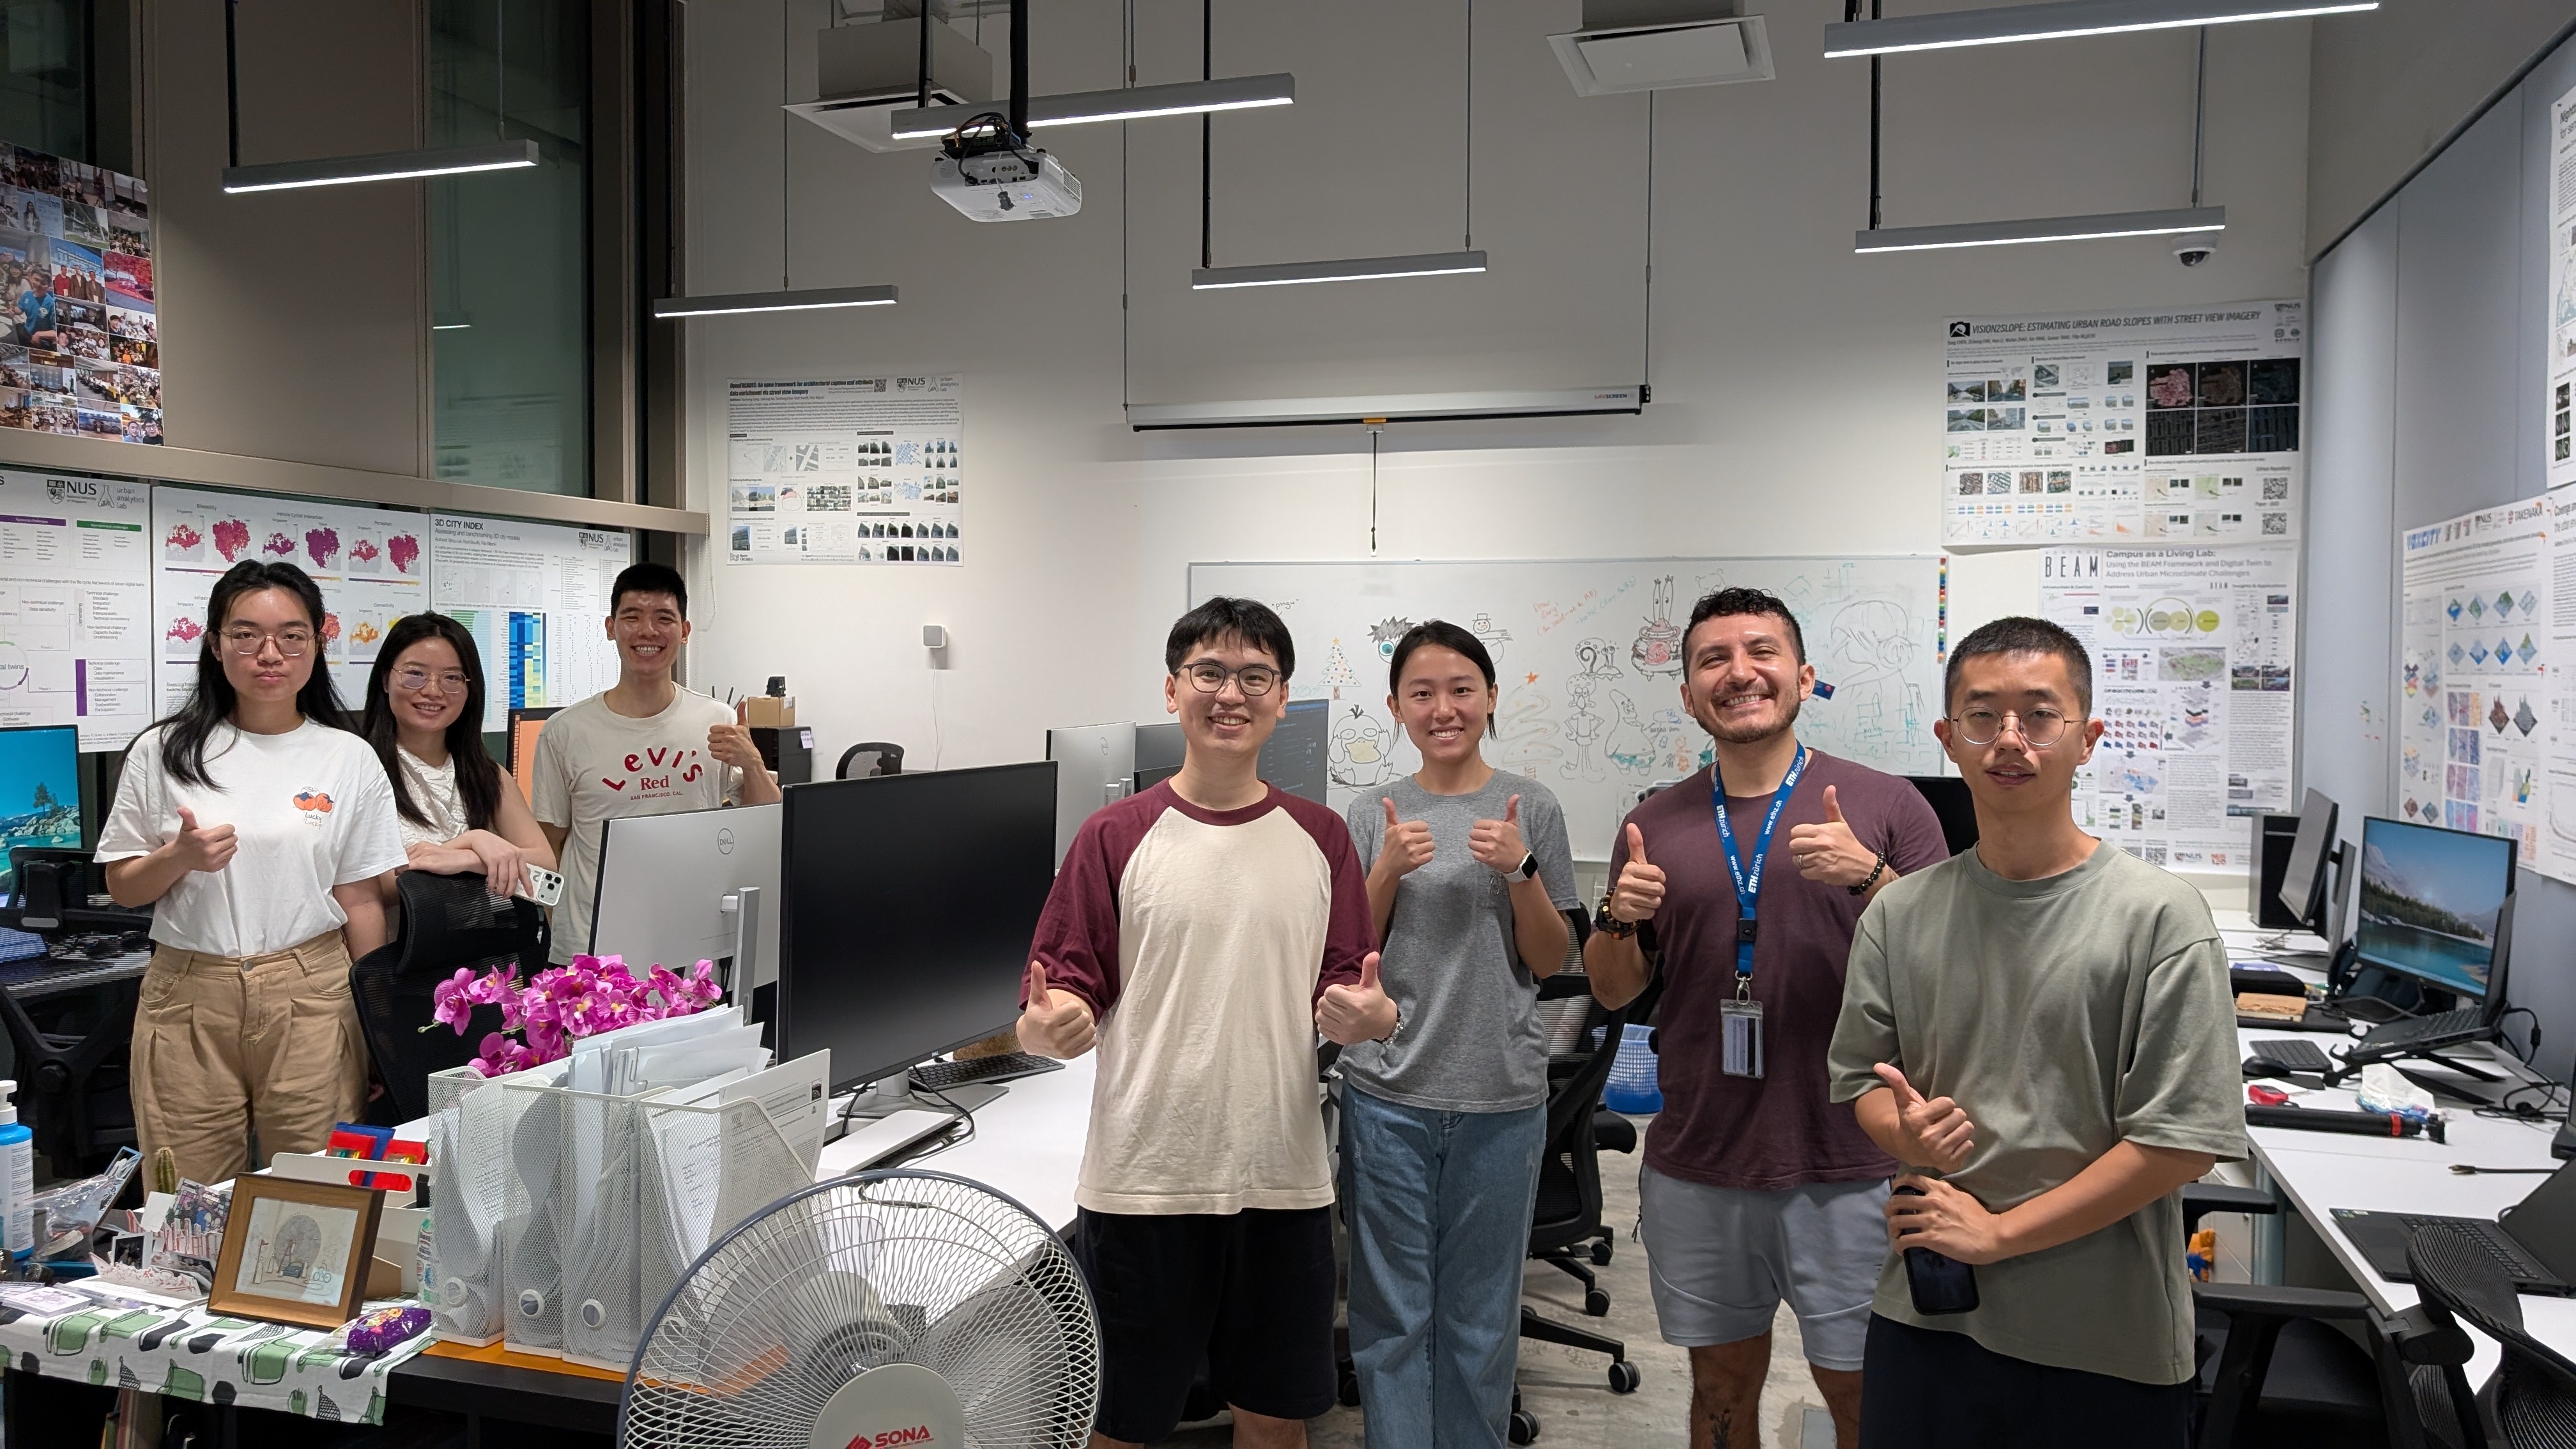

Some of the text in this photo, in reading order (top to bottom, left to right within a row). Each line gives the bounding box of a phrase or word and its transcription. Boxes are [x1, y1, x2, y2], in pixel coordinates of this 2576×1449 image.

[1972, 311, 2261, 334] VISION2SLOPE: ESTIMATING URBAN ROAD SLOPES WITH STREET VIEW IMAGERY
[66, 480, 97, 495] NUS
[117, 495, 144, 503] analytics
[446, 519, 463, 528] CITY
[463, 522, 484, 530] INDEX
[465, 530, 493, 539] benchmarking
[588, 533, 604, 543] NUS
[2106, 550, 2144, 559] Campus
[2166, 550, 2194, 558] Living
[2045, 556, 2098, 578] BEAM
[2106, 560, 2126, 569] Using
[2220, 559, 2244, 567] Digital
[2208, 570, 2251, 578] Challenges
[639, 775, 670, 791] Red
[1764, 799, 1783, 836] www.ethz.ch
[719, 837, 733, 846] DELL
[1729, 855, 1746, 895] www.ethz.ch
[875, 1425, 931, 1448] SONA
